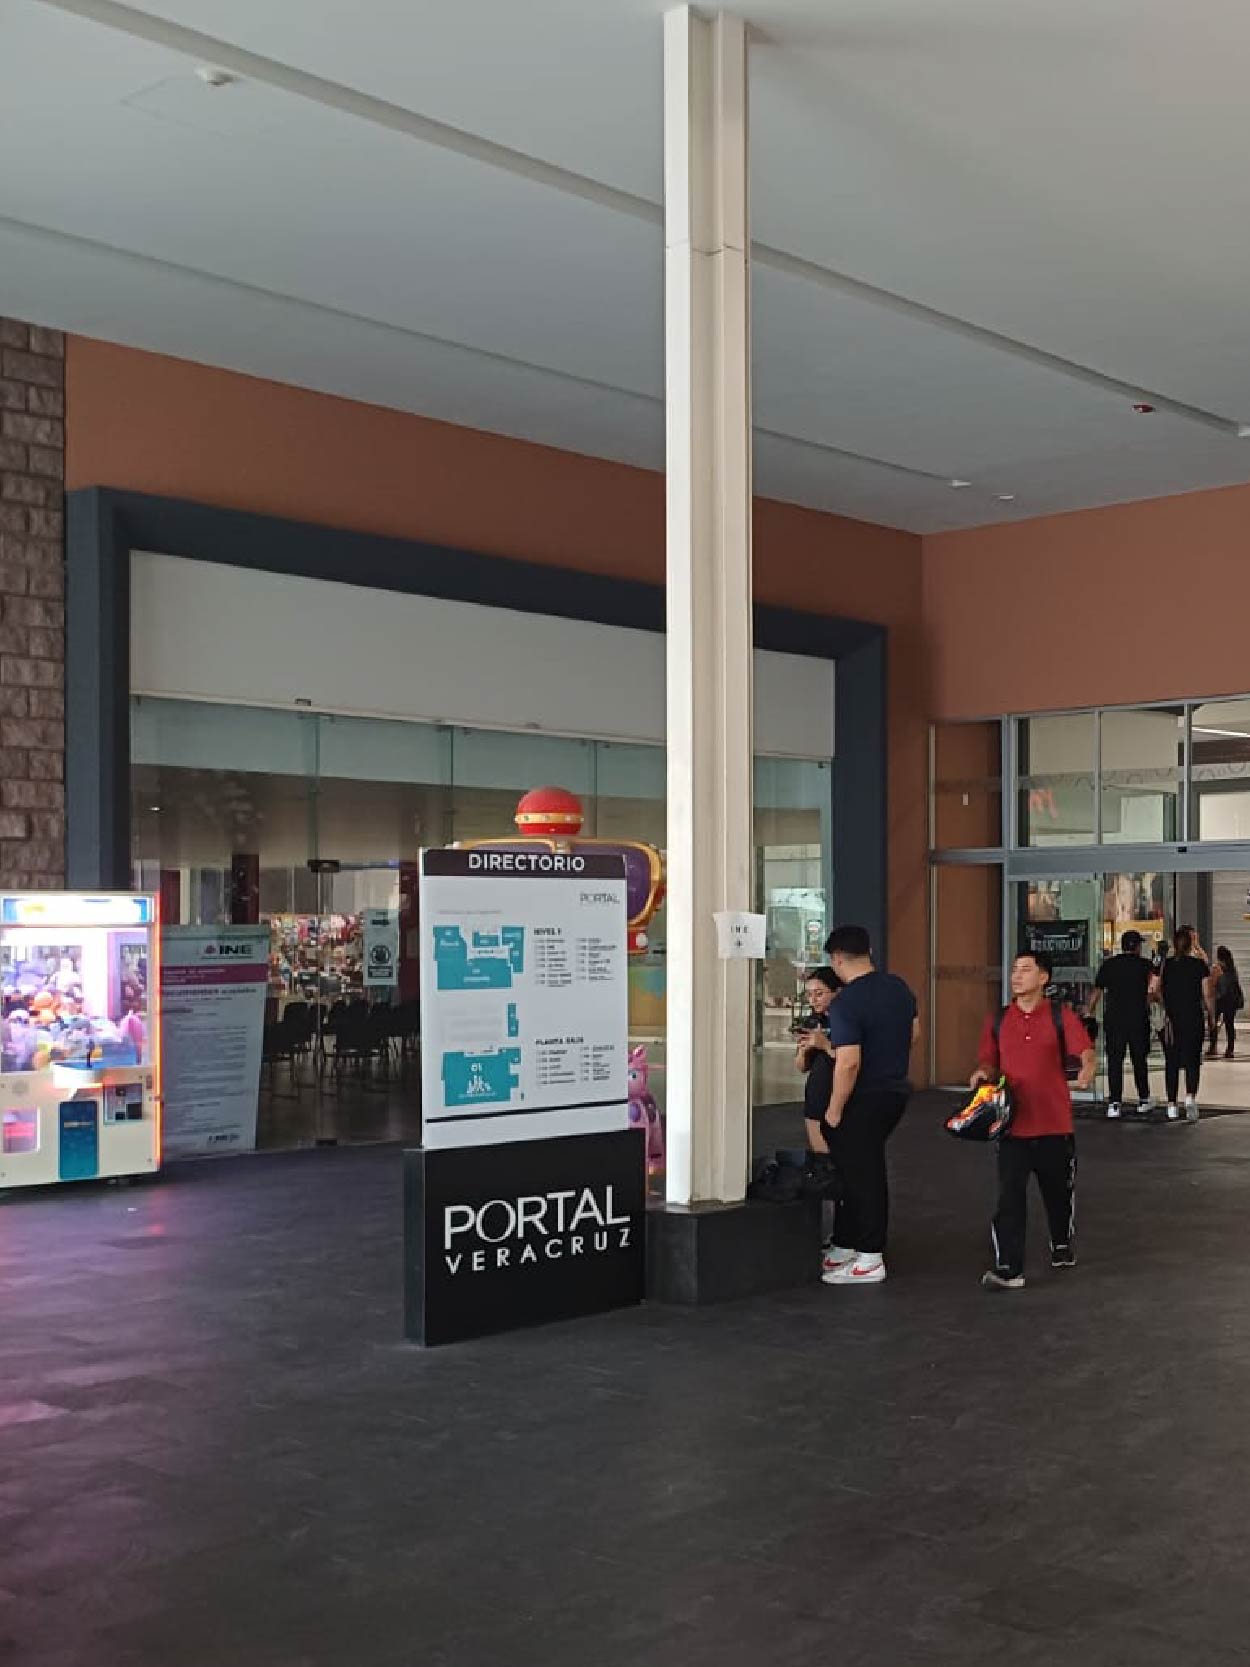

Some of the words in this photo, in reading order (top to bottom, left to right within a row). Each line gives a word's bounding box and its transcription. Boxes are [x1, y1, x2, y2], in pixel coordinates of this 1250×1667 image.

[468, 853, 585, 871] DIRECTORIO
[579, 893, 620, 904] PORTAL
[219, 945, 253, 955] INE
[444, 1185, 631, 1250] PORTAL
[445, 1227, 631, 1276] VERACRUZ
